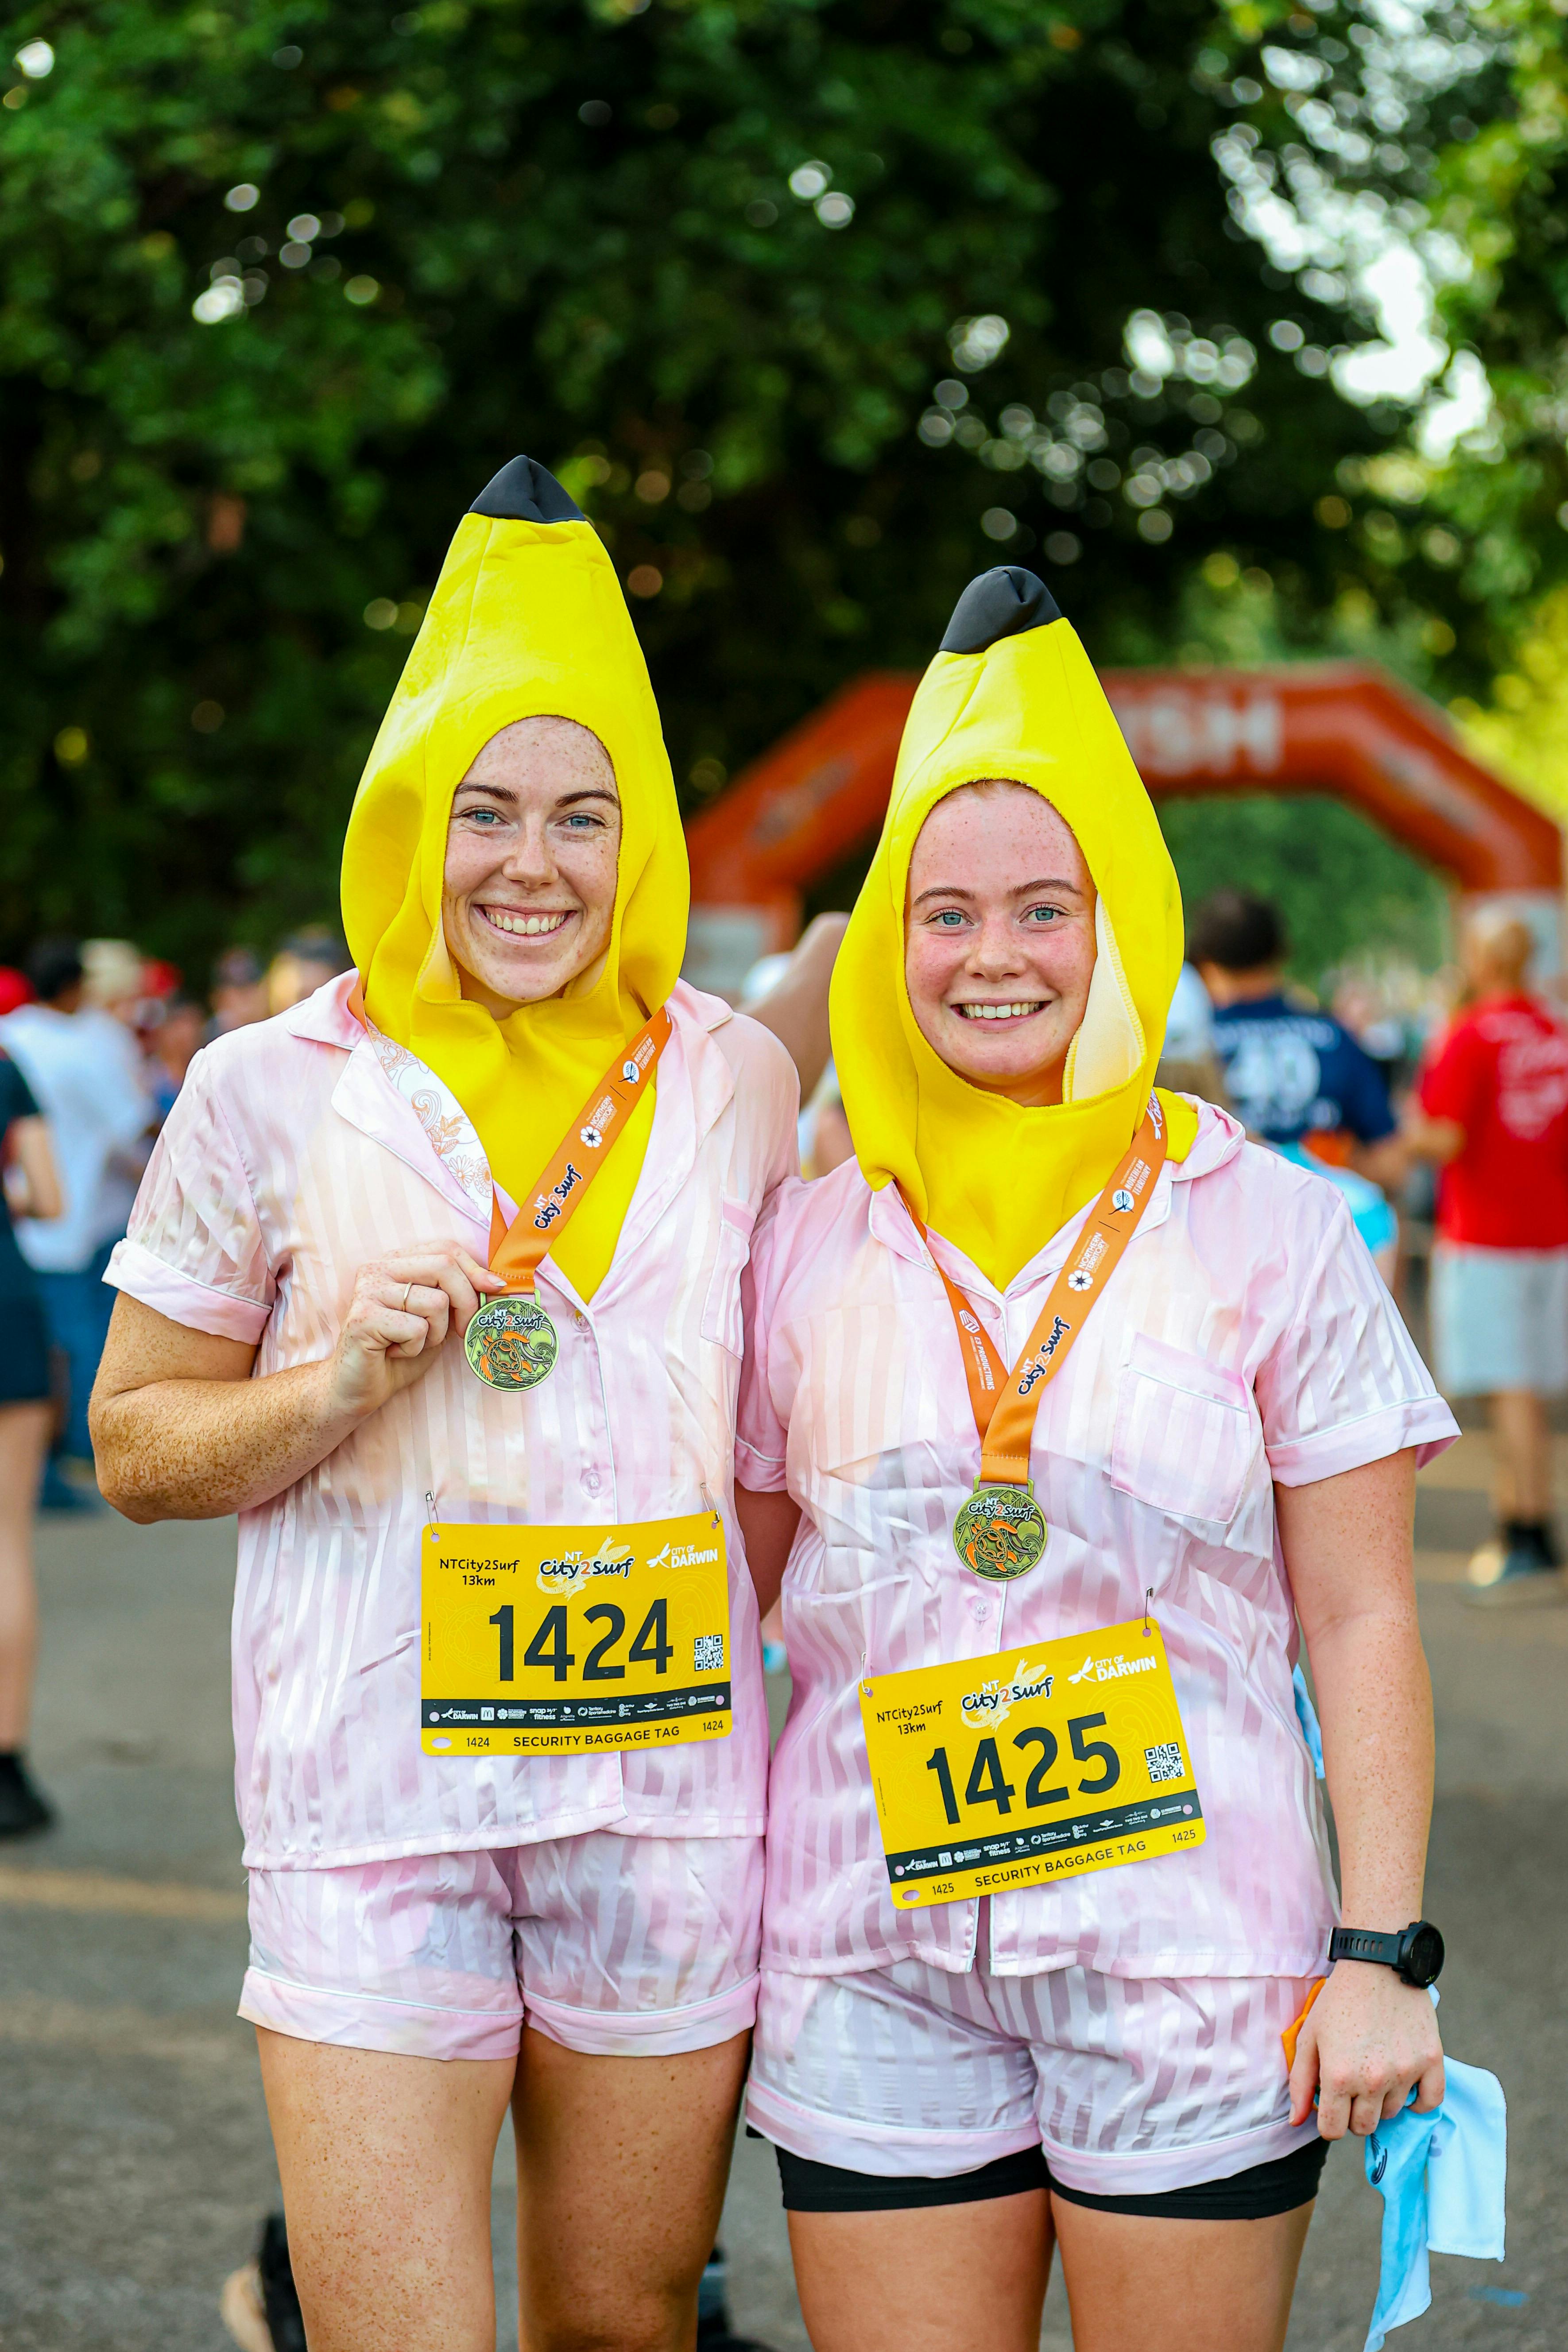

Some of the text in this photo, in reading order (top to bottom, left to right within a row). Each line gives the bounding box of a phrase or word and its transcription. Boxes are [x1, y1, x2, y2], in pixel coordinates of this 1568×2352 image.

[634, 1036, 652, 1063] NORTHERN
[639, 1043, 656, 1070] TERRITORY
[590, 1095, 612, 1127] NORTHERN
[596, 1103, 614, 1129] TERRITORY
[1124, 1159, 1145, 1190] NORTHERN
[1132, 1164, 1152, 1196] TERRITORY
[534, 1194, 548, 1209] NT
[1078, 1232, 1102, 1269] NORTHERN
[1084, 1239, 1106, 1272] TERRITORY
[477, 1314, 545, 1330] City2Surf
[977, 1345, 995, 1391] PRODUCTIONS
[1020, 1358, 1034, 1374] NT
[968, 1502, 1035, 1521] City2Surf
[565, 1551, 583, 1562] NT
[671, 1545, 695, 1556] CITY OF
[671, 1548, 718, 1569] DARWIN
[440, 1558, 520, 1573] NTCity2Surf
[539, 1557, 635, 1579] City2Surf
[462, 1575, 496, 1586] 13km
[489, 1598, 674, 1682] 1424
[1095, 1655, 1125, 1669] CITY OF
[1097, 1655, 1157, 1682] DARWIN
[961, 1674, 1054, 1712] City2Surf
[982, 1679, 1000, 1693] NT
[877, 1701, 943, 1723] NTCity2Surf
[466, 1720, 724, 1748] 1424 SECURITY BAGGAGE TAG 1424
[898, 1721, 926, 1736] 13km
[926, 1712, 1121, 1825] 1425
[983, 1844, 999, 1852] snap
[988, 1848, 1010, 1857] fitness
[916, 1861, 938, 1870] DARWIN
[932, 1829, 1196, 1895] 1425 SECURITY BAGGAGE TAG 1425
